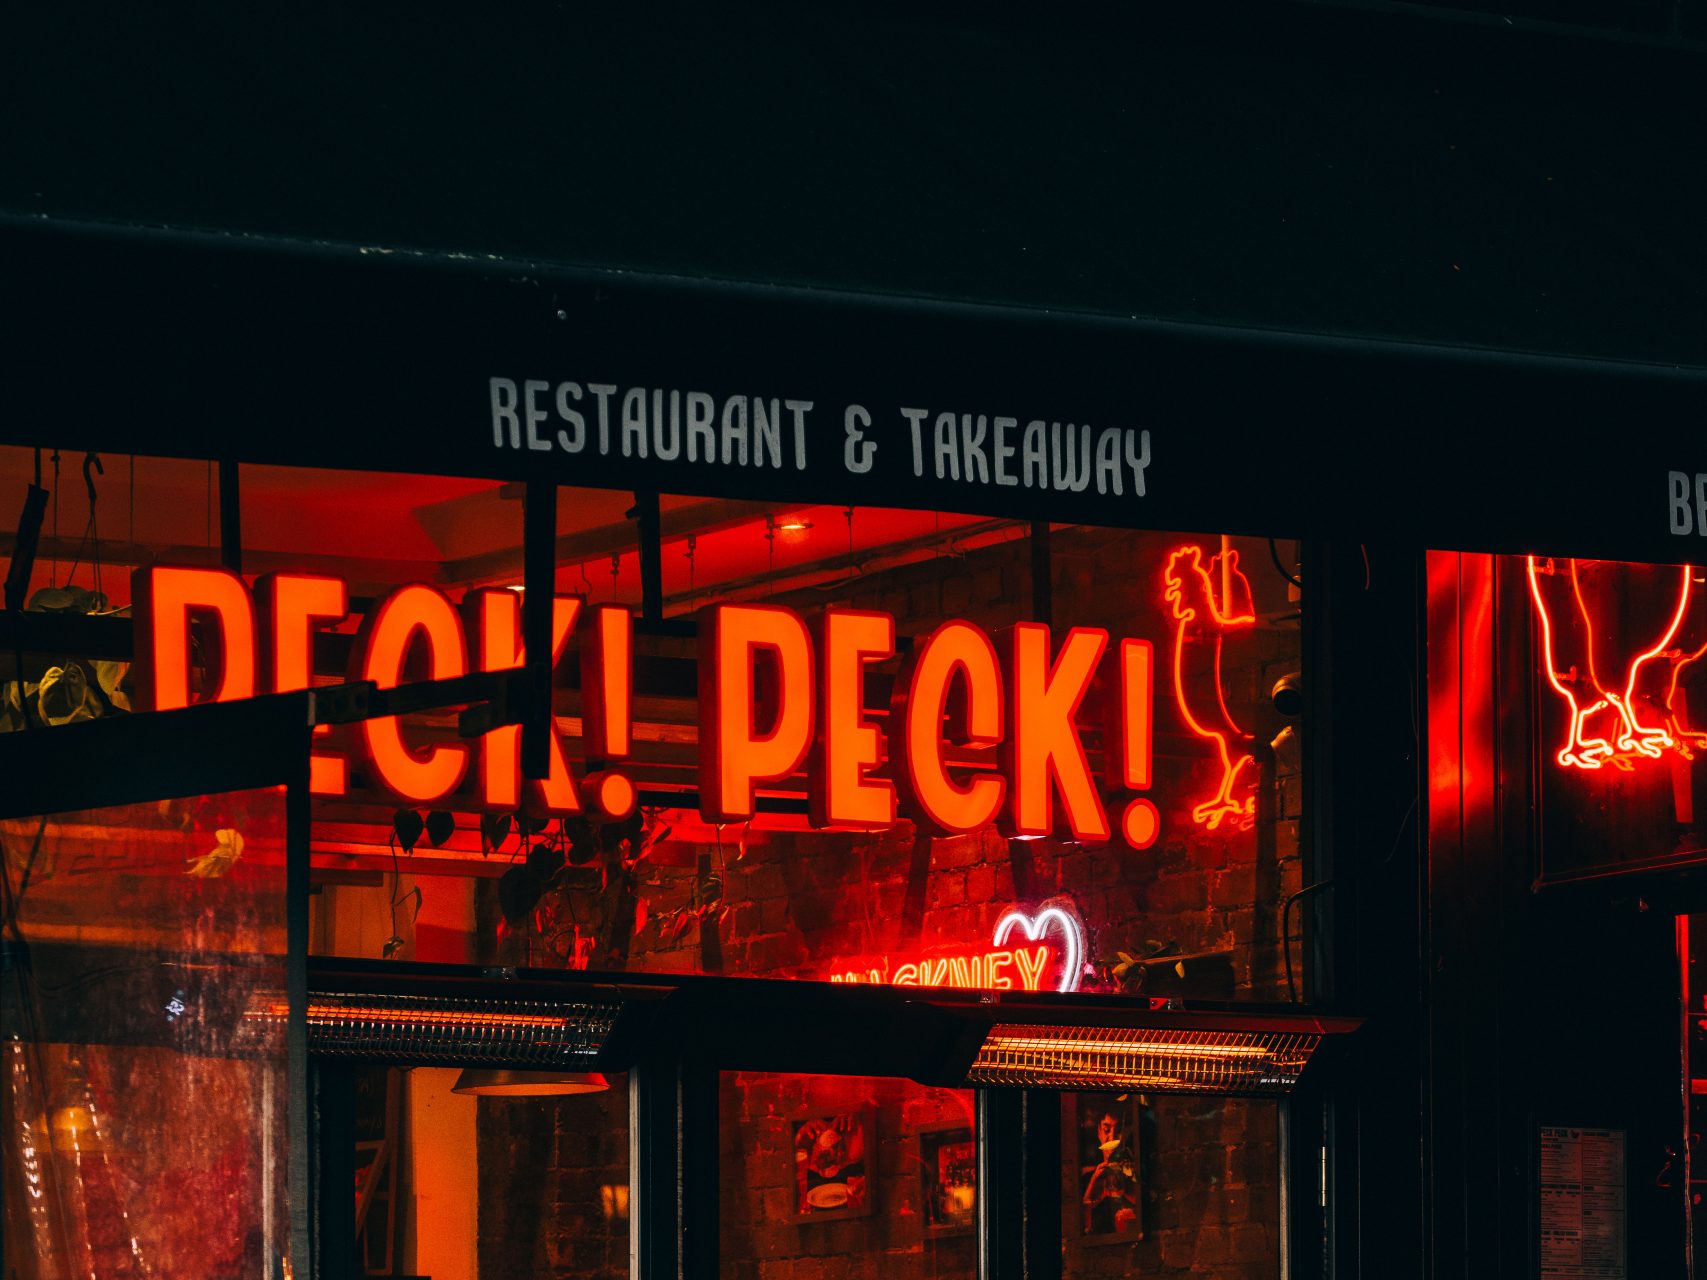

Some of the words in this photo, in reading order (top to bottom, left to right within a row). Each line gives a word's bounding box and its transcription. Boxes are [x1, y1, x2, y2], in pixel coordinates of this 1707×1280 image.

[489, 376, 814, 470] RESTAURANT
[844, 404, 877, 473] &
[900, 407, 1151, 496] TAKEAWAY
[716, 603, 1161, 850] PECK!
